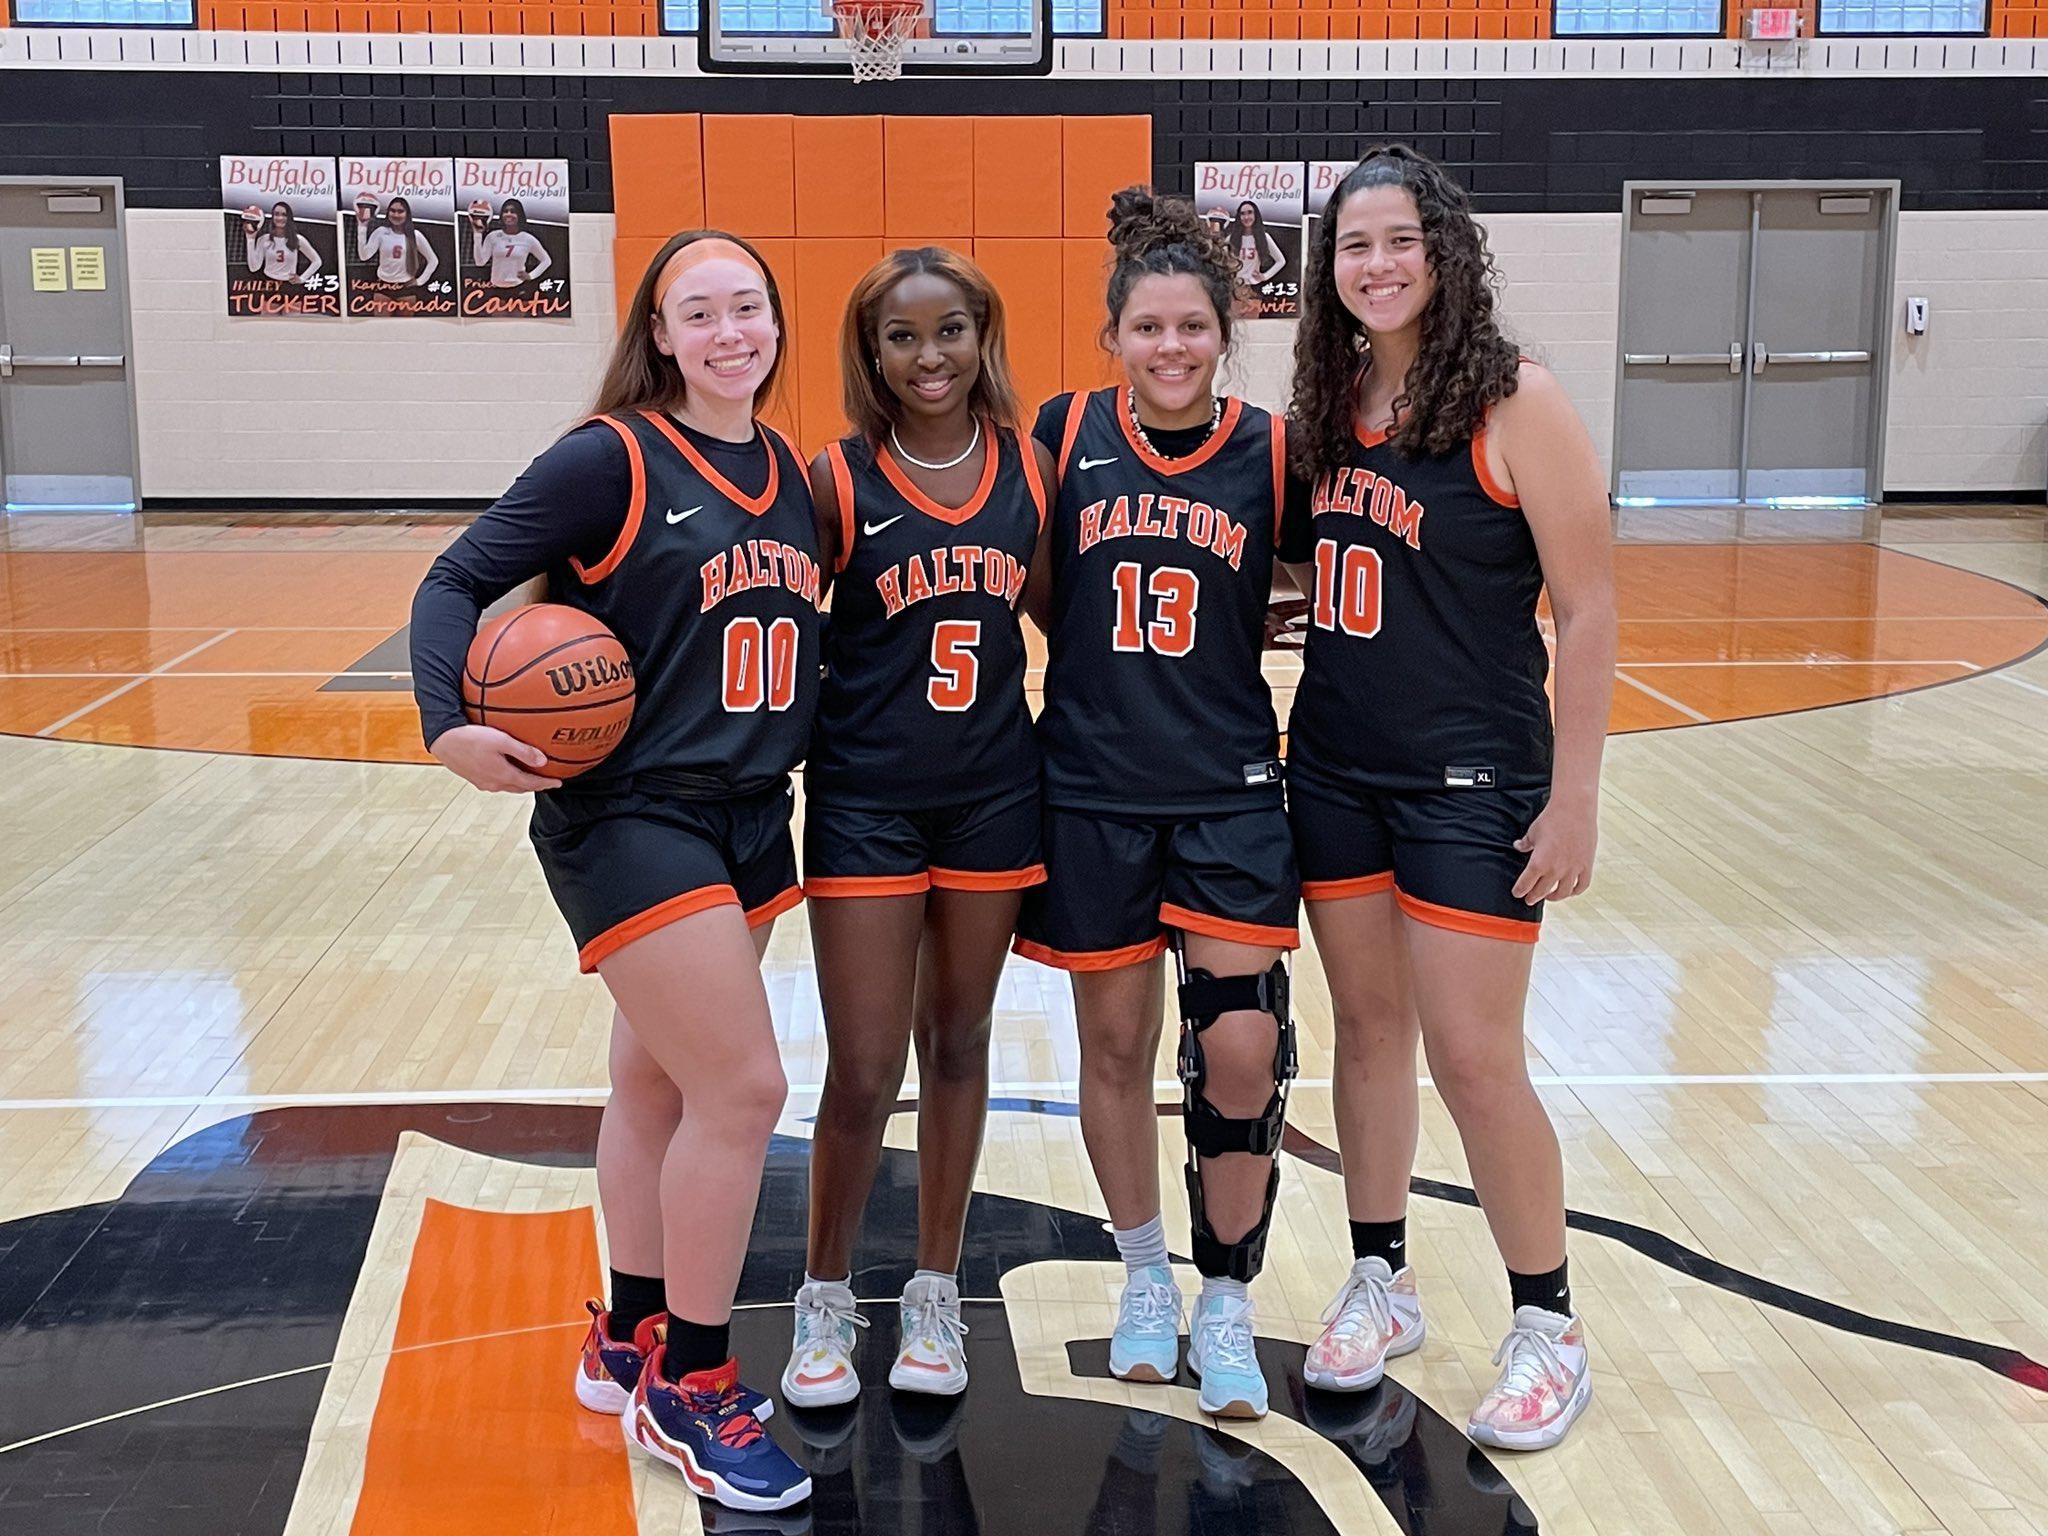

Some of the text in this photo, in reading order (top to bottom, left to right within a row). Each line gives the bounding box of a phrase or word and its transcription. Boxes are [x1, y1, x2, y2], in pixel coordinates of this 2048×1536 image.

[228, 160, 326, 192] Buffalo
[346, 161, 443, 193] Buffalo
[462, 162, 558, 194] Buffalo
[1202, 164, 1295, 197] Buffalo
[278, 184, 334, 198] Volleyball
[396, 186, 451, 198] Volleyball
[512, 186, 566, 199] Volleyball
[1249, 189, 1301, 201] Volleyball
[275, 250, 285, 263] 3
[504, 245, 515, 258] 7
[232, 280, 283, 291] HAILEY
[304, 273, 340, 292] #3
[351, 279, 403, 291] Karina
[427, 280, 453, 293] #6
[538, 278, 566, 293] #7
[1261, 282, 1299, 297] #13
[229, 293, 340, 314] TUCKER
[350, 294, 457, 313] Coronado
[463, 289, 570, 317] Cantu
[1312, 467, 1425, 551] ALTOM
[1079, 494, 1248, 572] HALTOM
[700, 539, 821, 614] HALTOM
[875, 545, 1027, 620] HALTOM
[1313, 537, 1383, 640] 10
[1112, 561, 1200, 658] 13
[721, 616, 799, 712] 00
[926, 619, 982, 712] 5
[1477, 772, 1492, 783] XL
